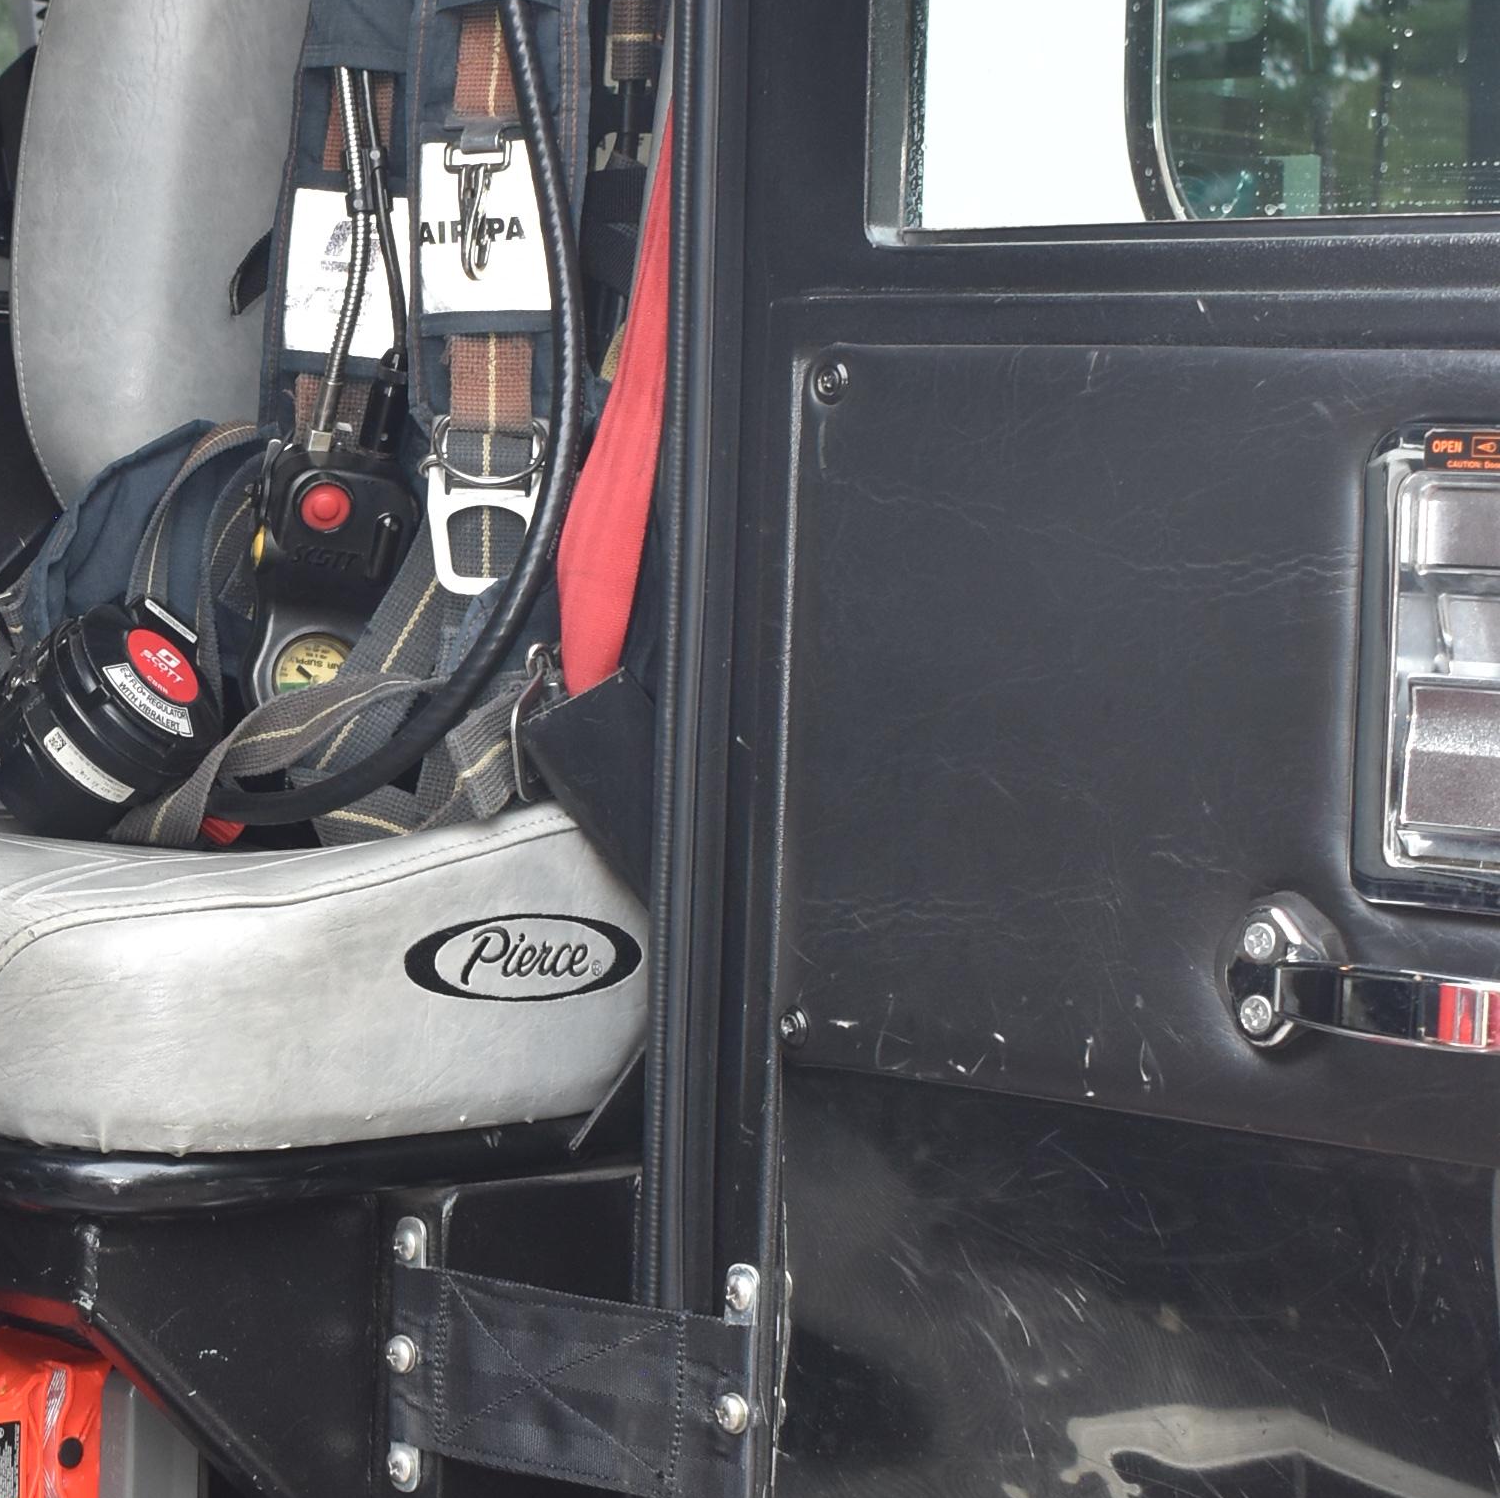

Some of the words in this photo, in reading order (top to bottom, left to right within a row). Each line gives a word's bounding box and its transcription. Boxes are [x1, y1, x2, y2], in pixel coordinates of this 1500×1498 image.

[1432, 439, 1463, 453] OPEN
[141, 649, 184, 682] SCOTT
[120, 682, 139, 704] WITH
[138, 701, 181, 731] VIBRALERT
[147, 694, 187, 719] REGULATOR
[460, 926, 589, 986] Pierce
